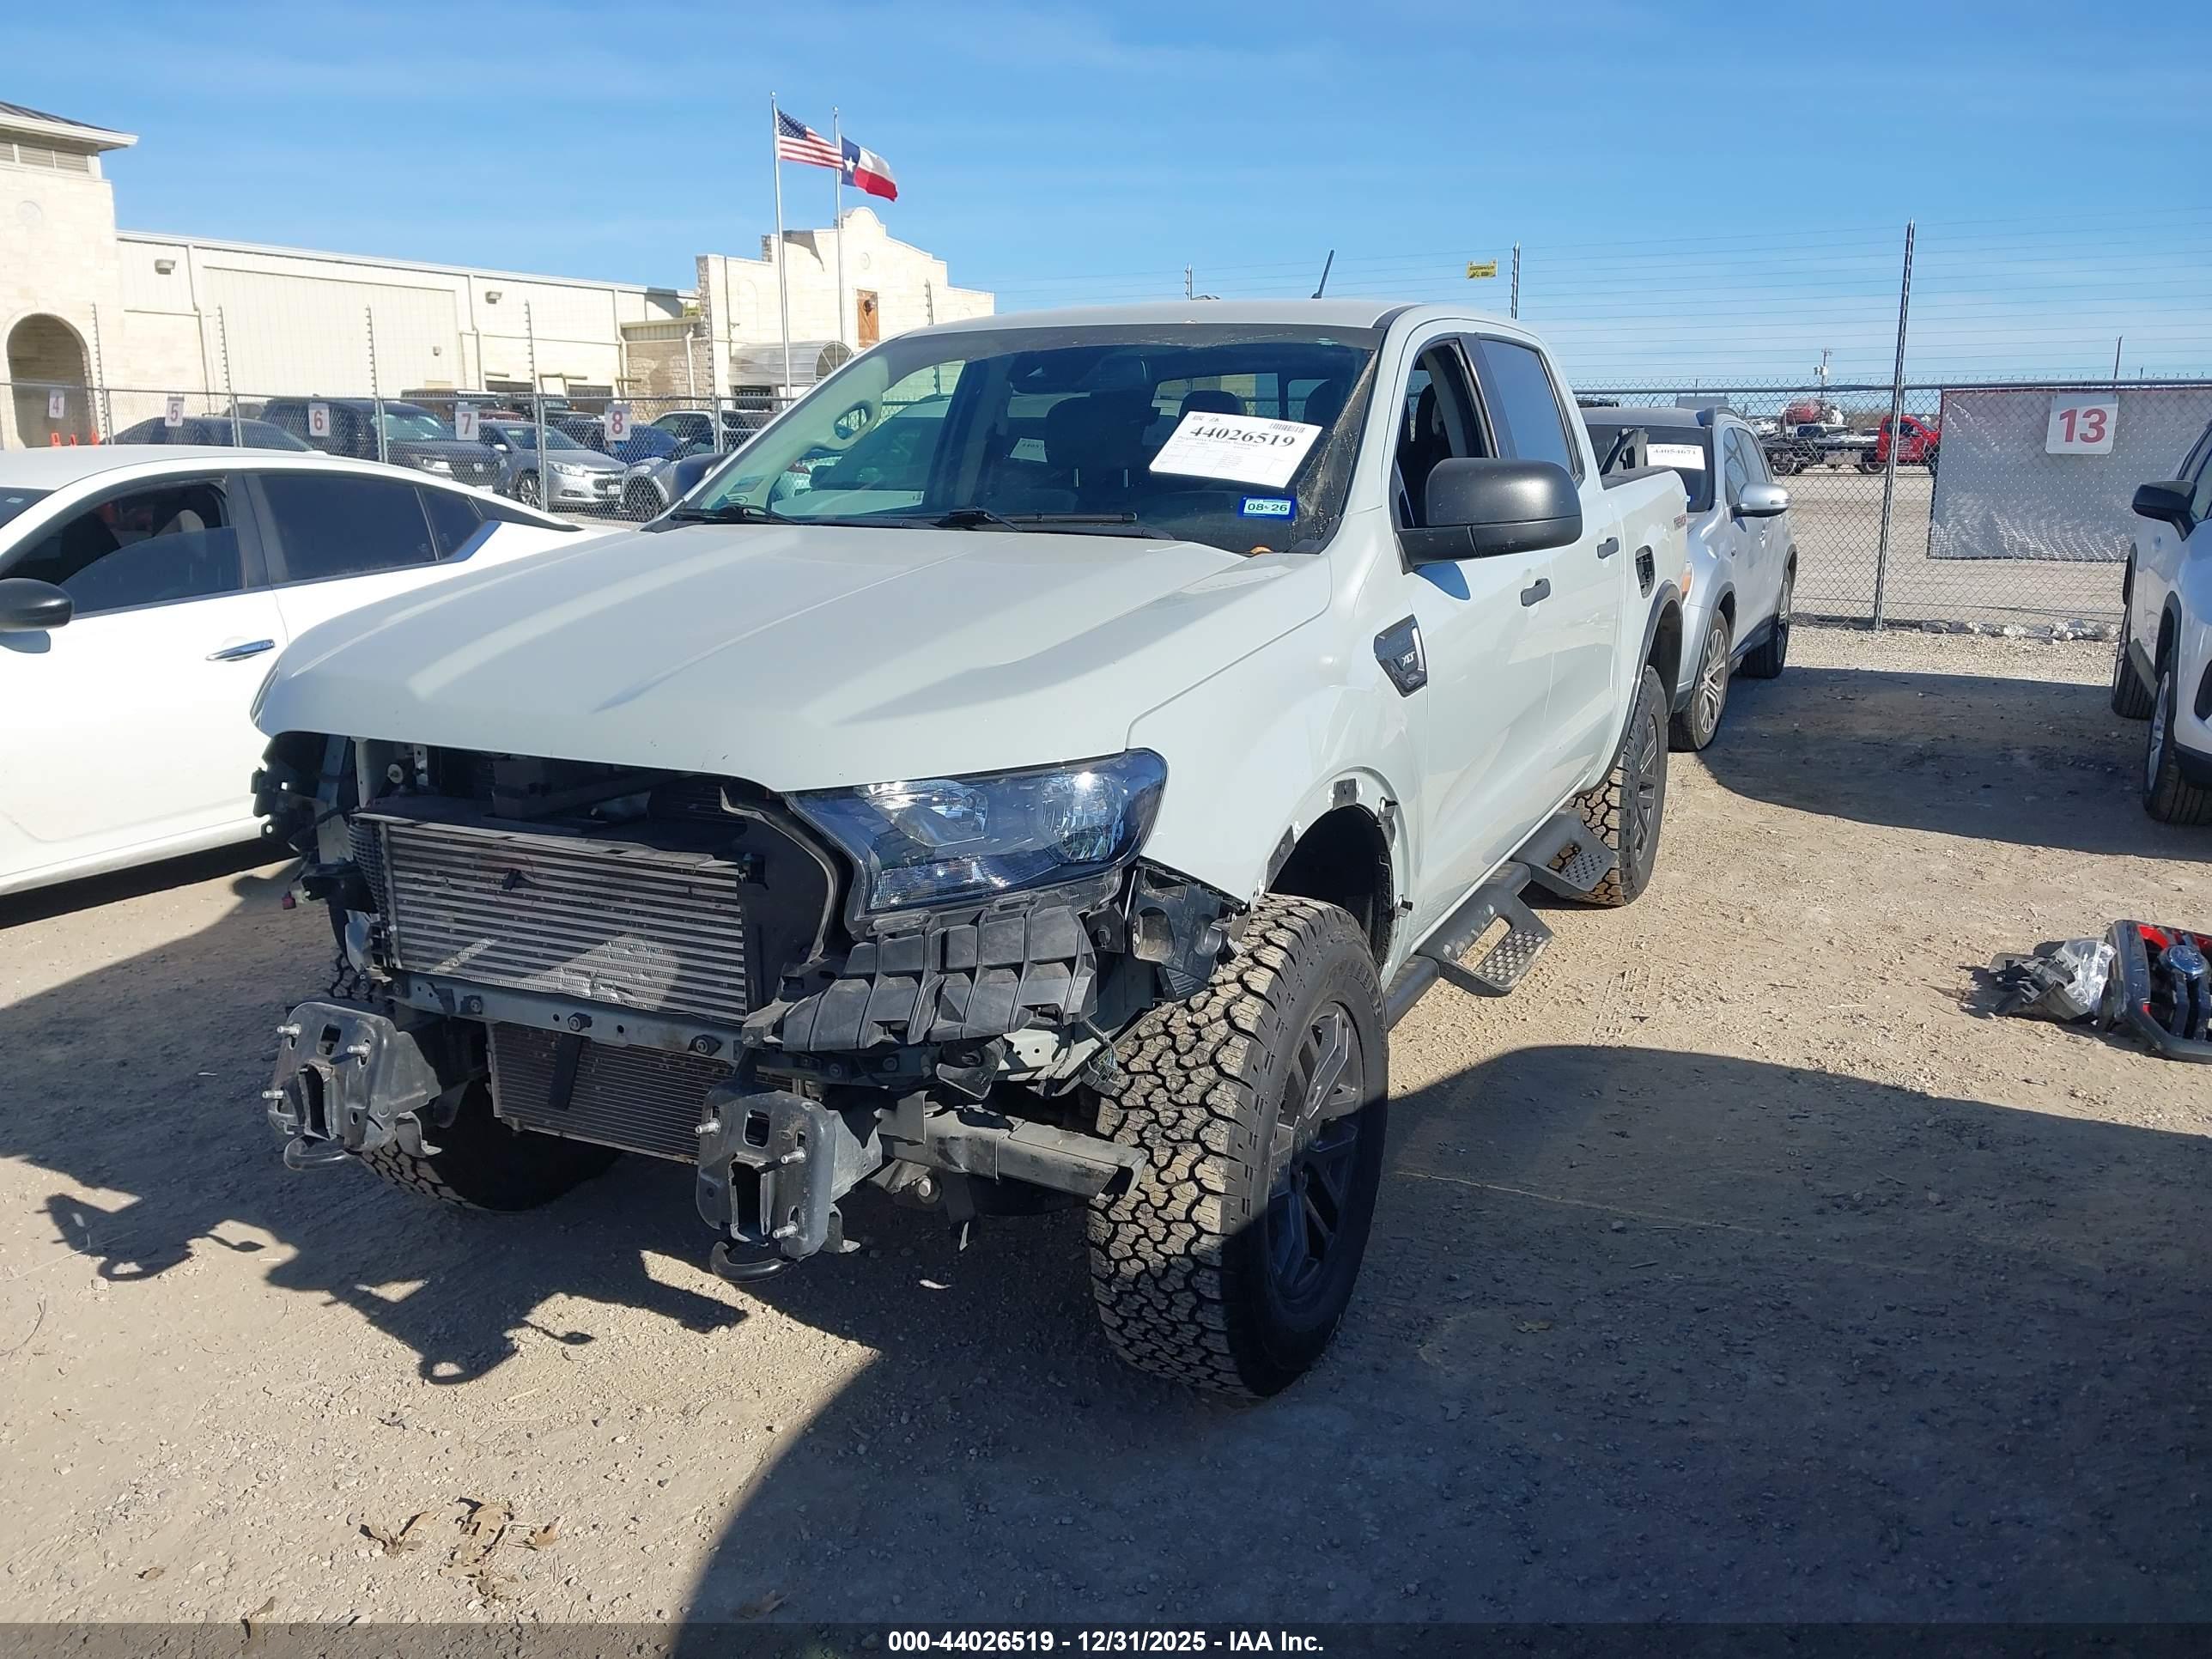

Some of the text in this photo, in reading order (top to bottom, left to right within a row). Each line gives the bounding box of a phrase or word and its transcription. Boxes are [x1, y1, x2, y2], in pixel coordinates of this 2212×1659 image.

[52, 395, 60, 414] 4
[170, 404, 179, 422] 5
[313, 411, 324, 432] 6
[461, 413, 473, 435] 7
[611, 410, 624, 434] 8
[2059, 408, 2108, 443] 13
[1190, 425, 1296, 447] 44026519
